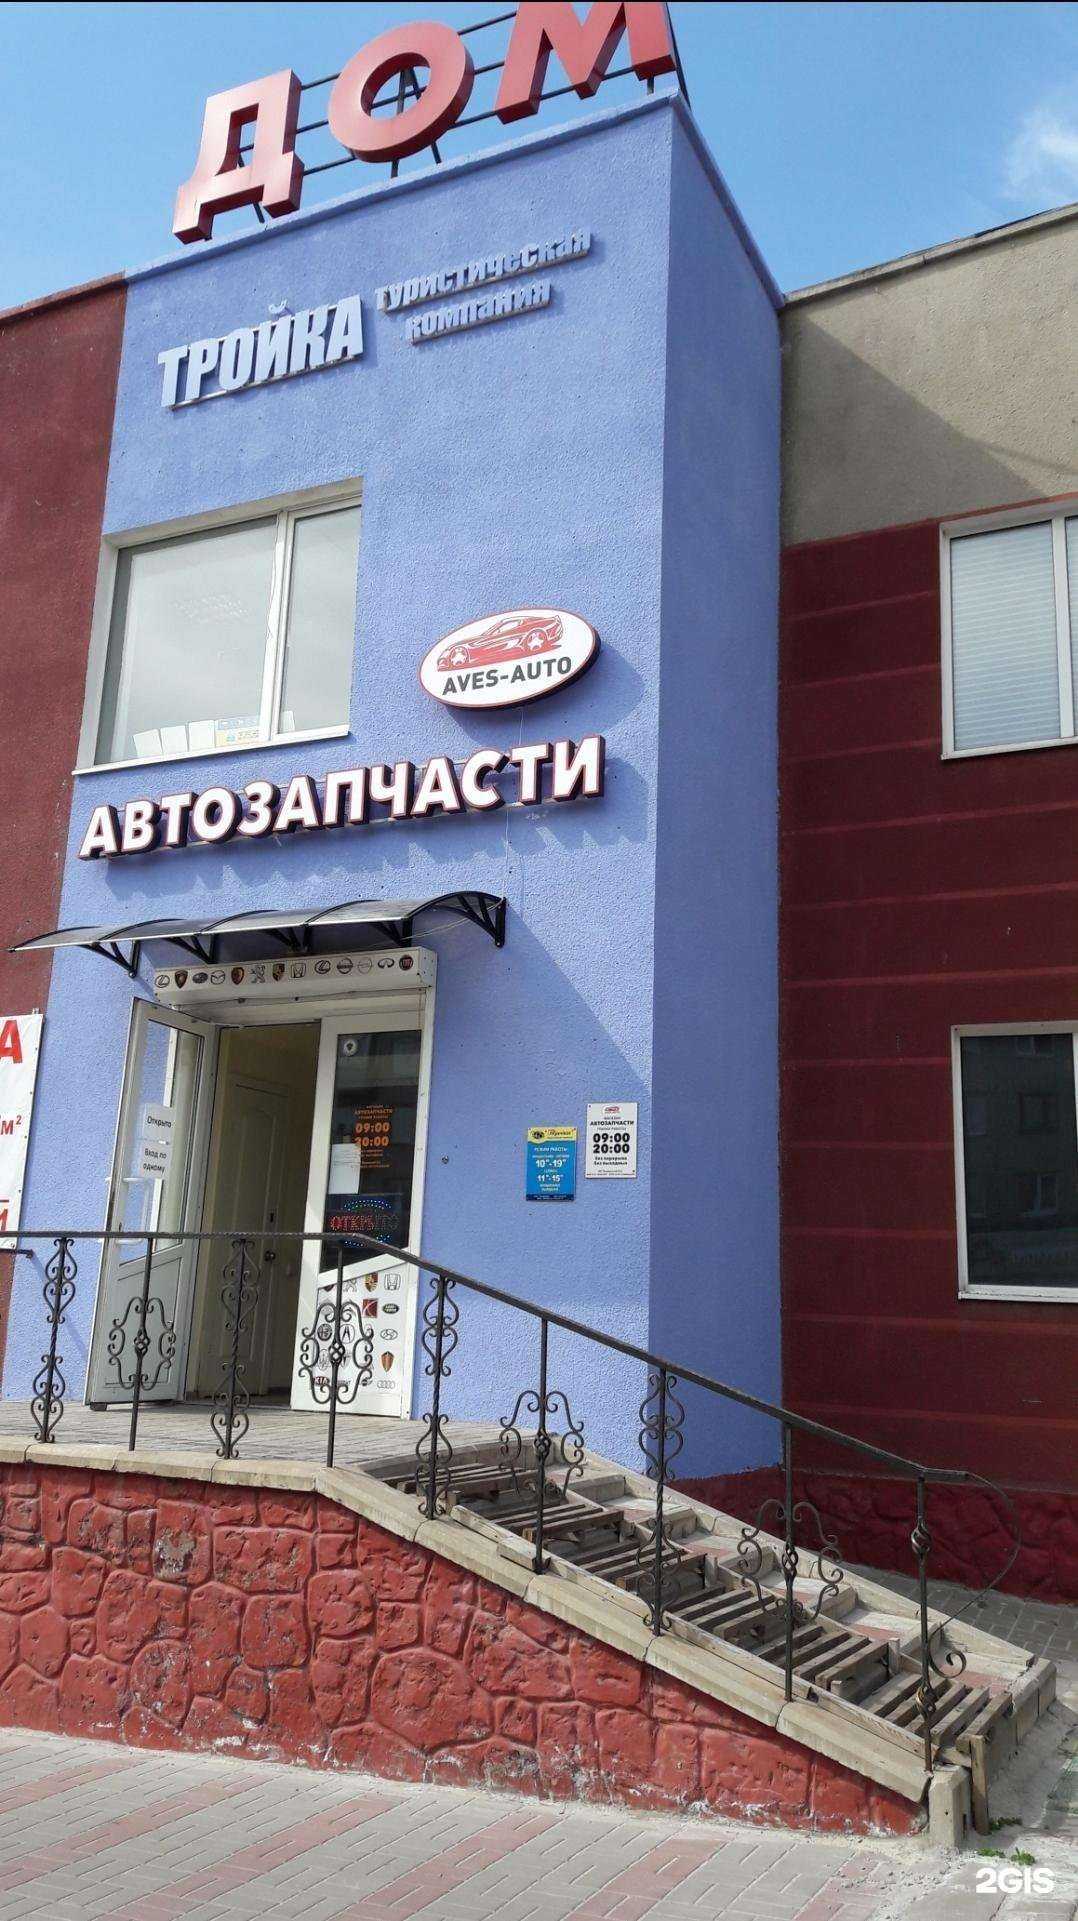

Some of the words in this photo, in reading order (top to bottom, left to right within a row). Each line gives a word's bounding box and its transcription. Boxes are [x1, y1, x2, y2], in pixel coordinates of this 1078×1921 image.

[172, 2, 676, 244] ДОМ
[157, 295, 365, 409] ТРОЙКА
[442, 656, 572, 696] AVES-AUTO
[78, 735, 606, 861] АВТОЗАПЧАСТИ
[355, 1122, 390, 1133] 09:00
[593, 1133, 630, 1143] 09:00
[593, 1144, 630, 1154] 20:00
